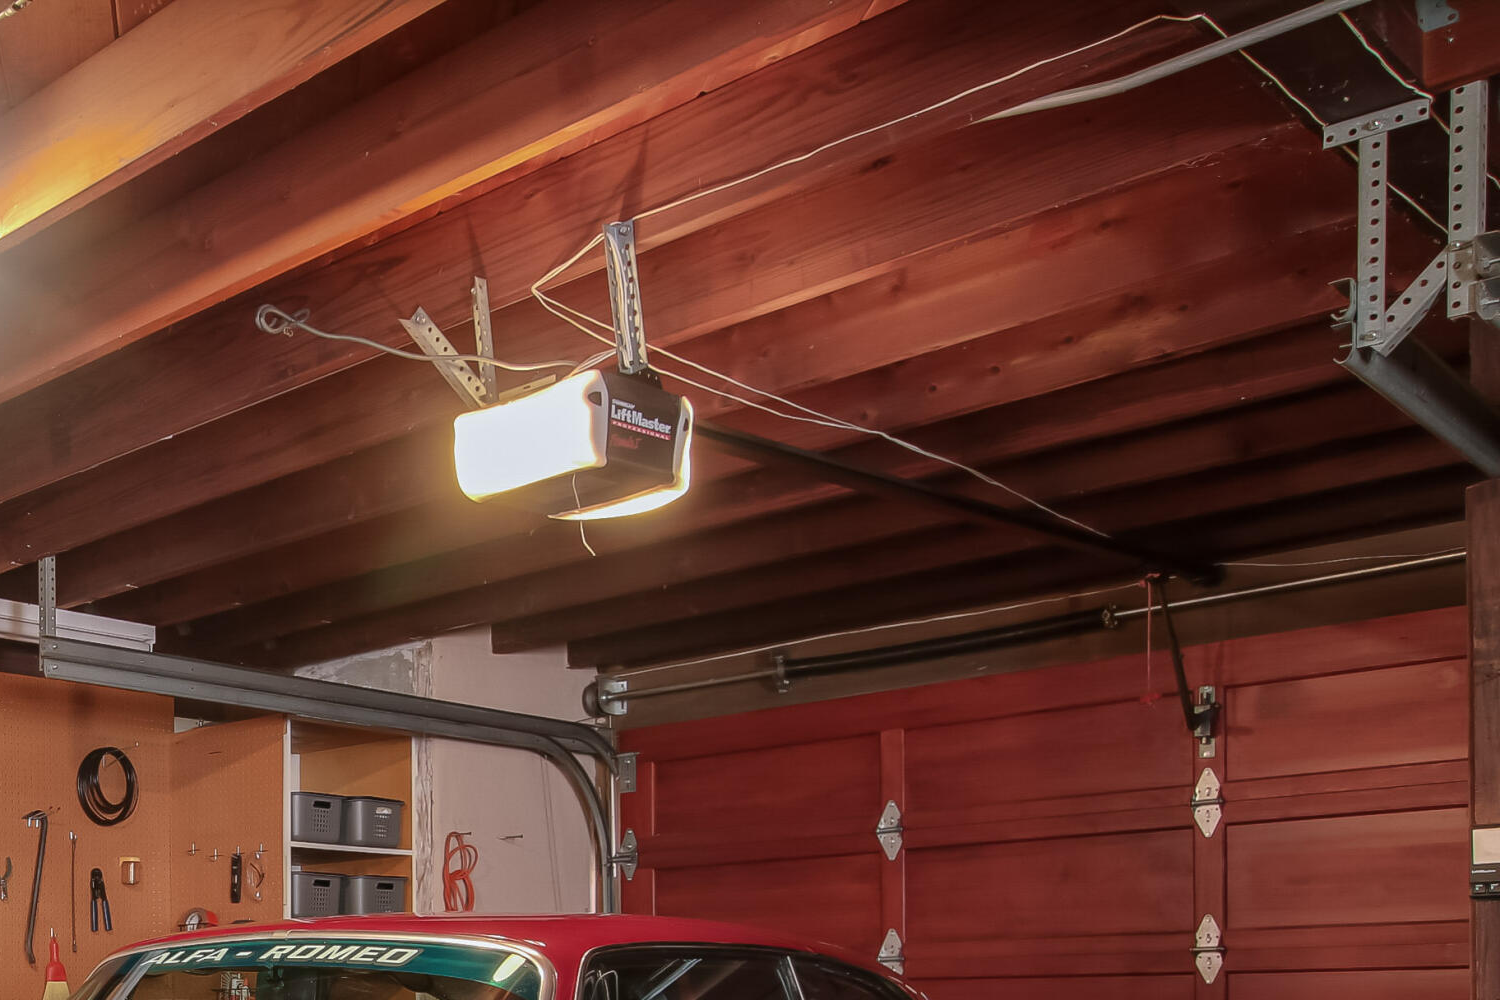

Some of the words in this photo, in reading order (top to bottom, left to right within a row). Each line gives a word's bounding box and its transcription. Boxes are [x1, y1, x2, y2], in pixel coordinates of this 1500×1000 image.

[611, 403, 672, 434] LiftMaster
[141, 947, 229, 966] ALFA
[258, 945, 423, 967] ROMEO
